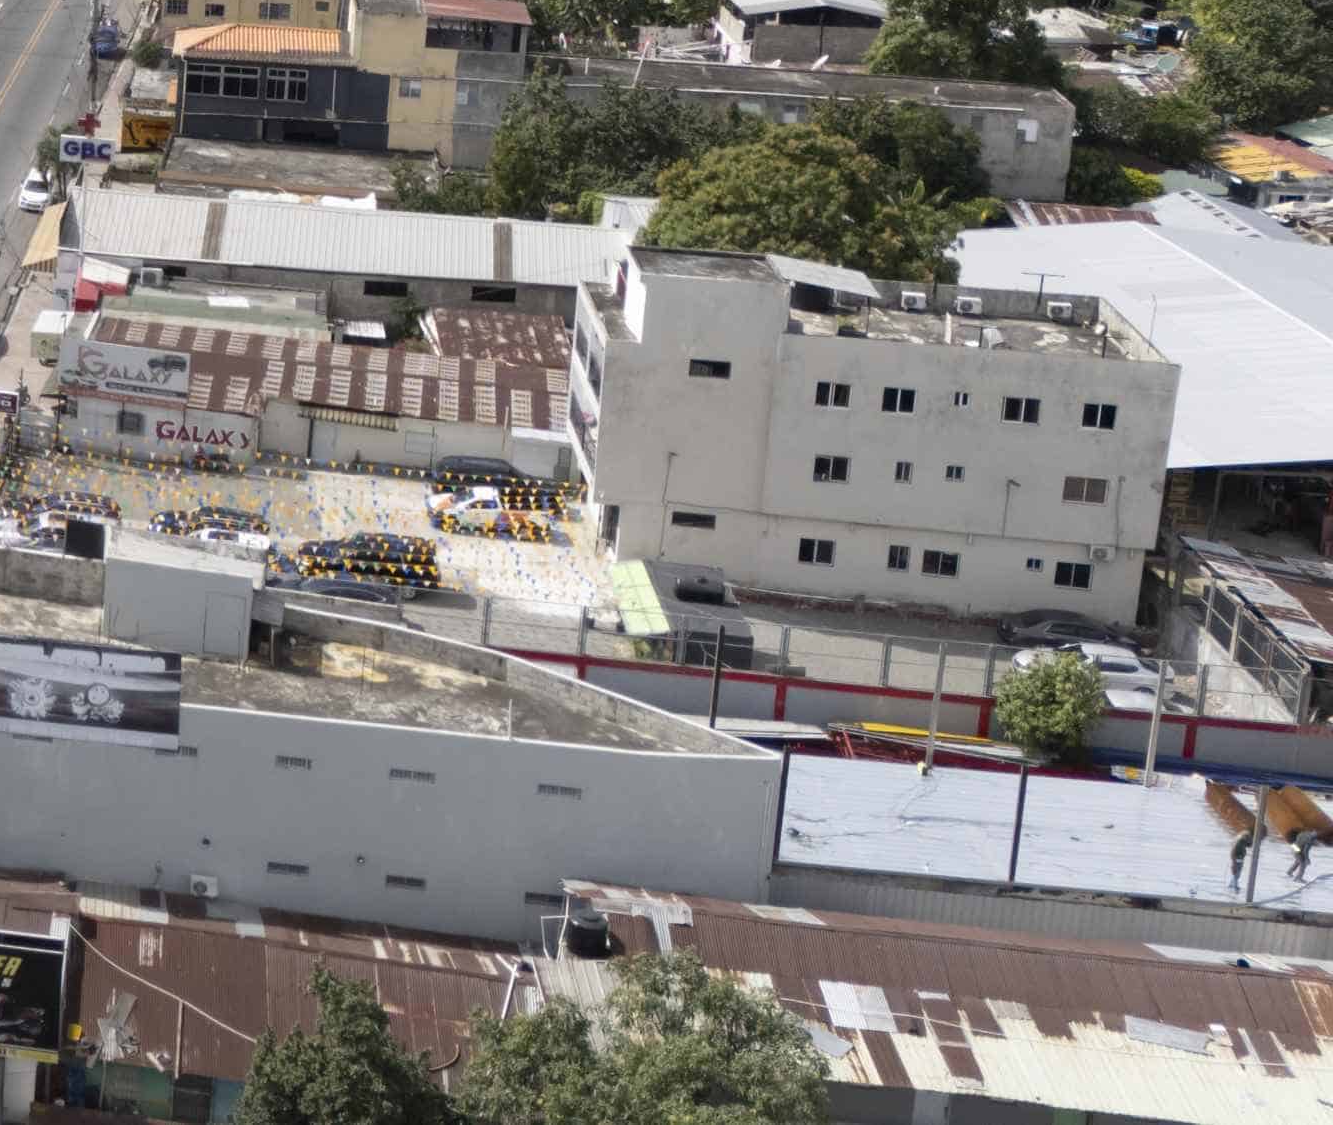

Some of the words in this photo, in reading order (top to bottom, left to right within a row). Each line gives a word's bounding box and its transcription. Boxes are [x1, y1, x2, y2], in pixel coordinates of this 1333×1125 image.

[64, 140, 111, 159] GBC
[77, 346, 173, 385] GALAXY
[156, 420, 251, 449] GALAXY
